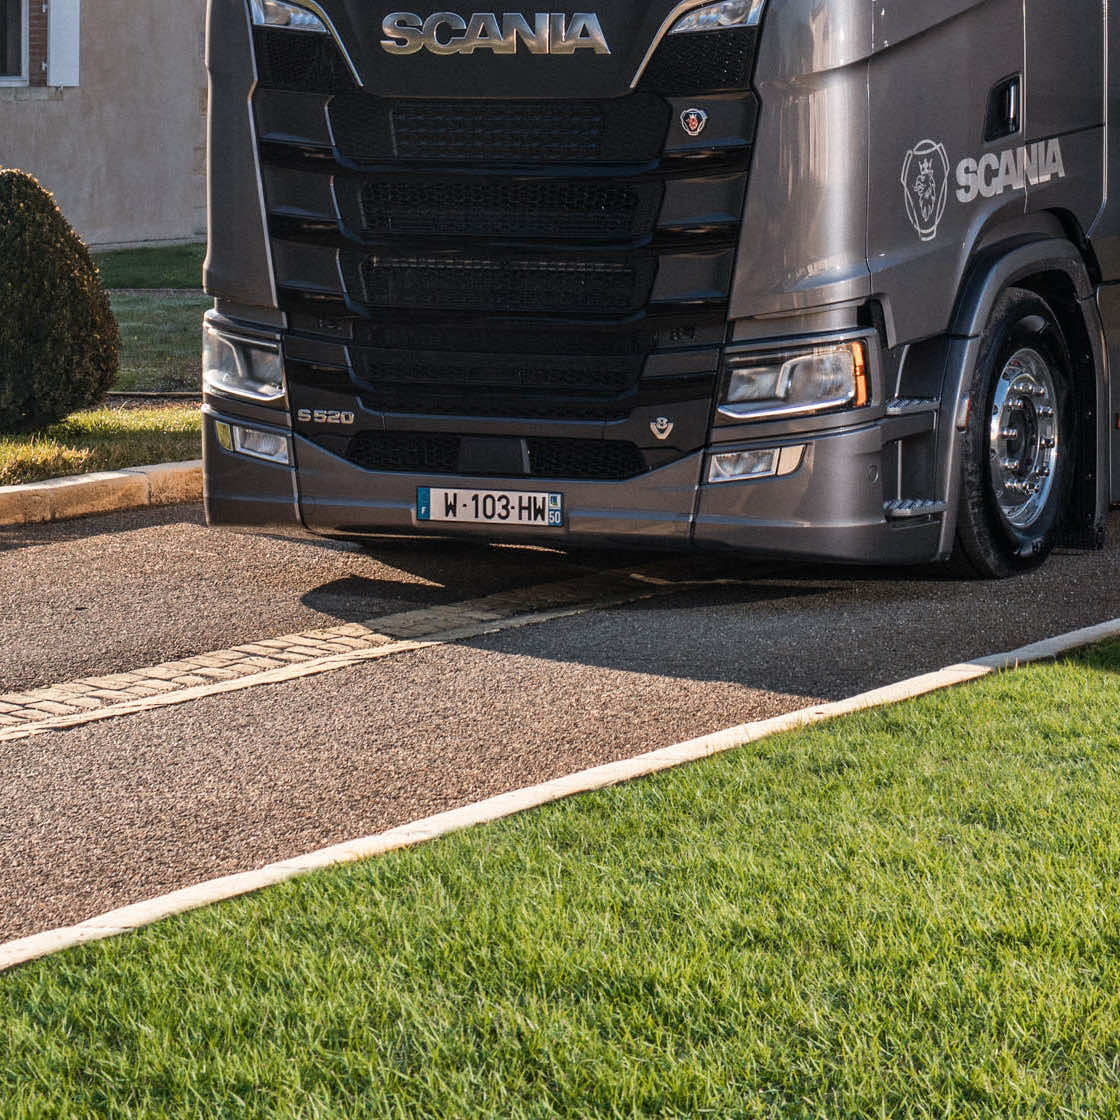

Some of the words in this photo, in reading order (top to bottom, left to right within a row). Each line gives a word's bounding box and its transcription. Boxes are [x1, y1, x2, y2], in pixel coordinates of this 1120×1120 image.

[380, 11, 611, 55] SCANIA
[955, 137, 1065, 203] SCANIA
[549, 511, 561, 523] 50
